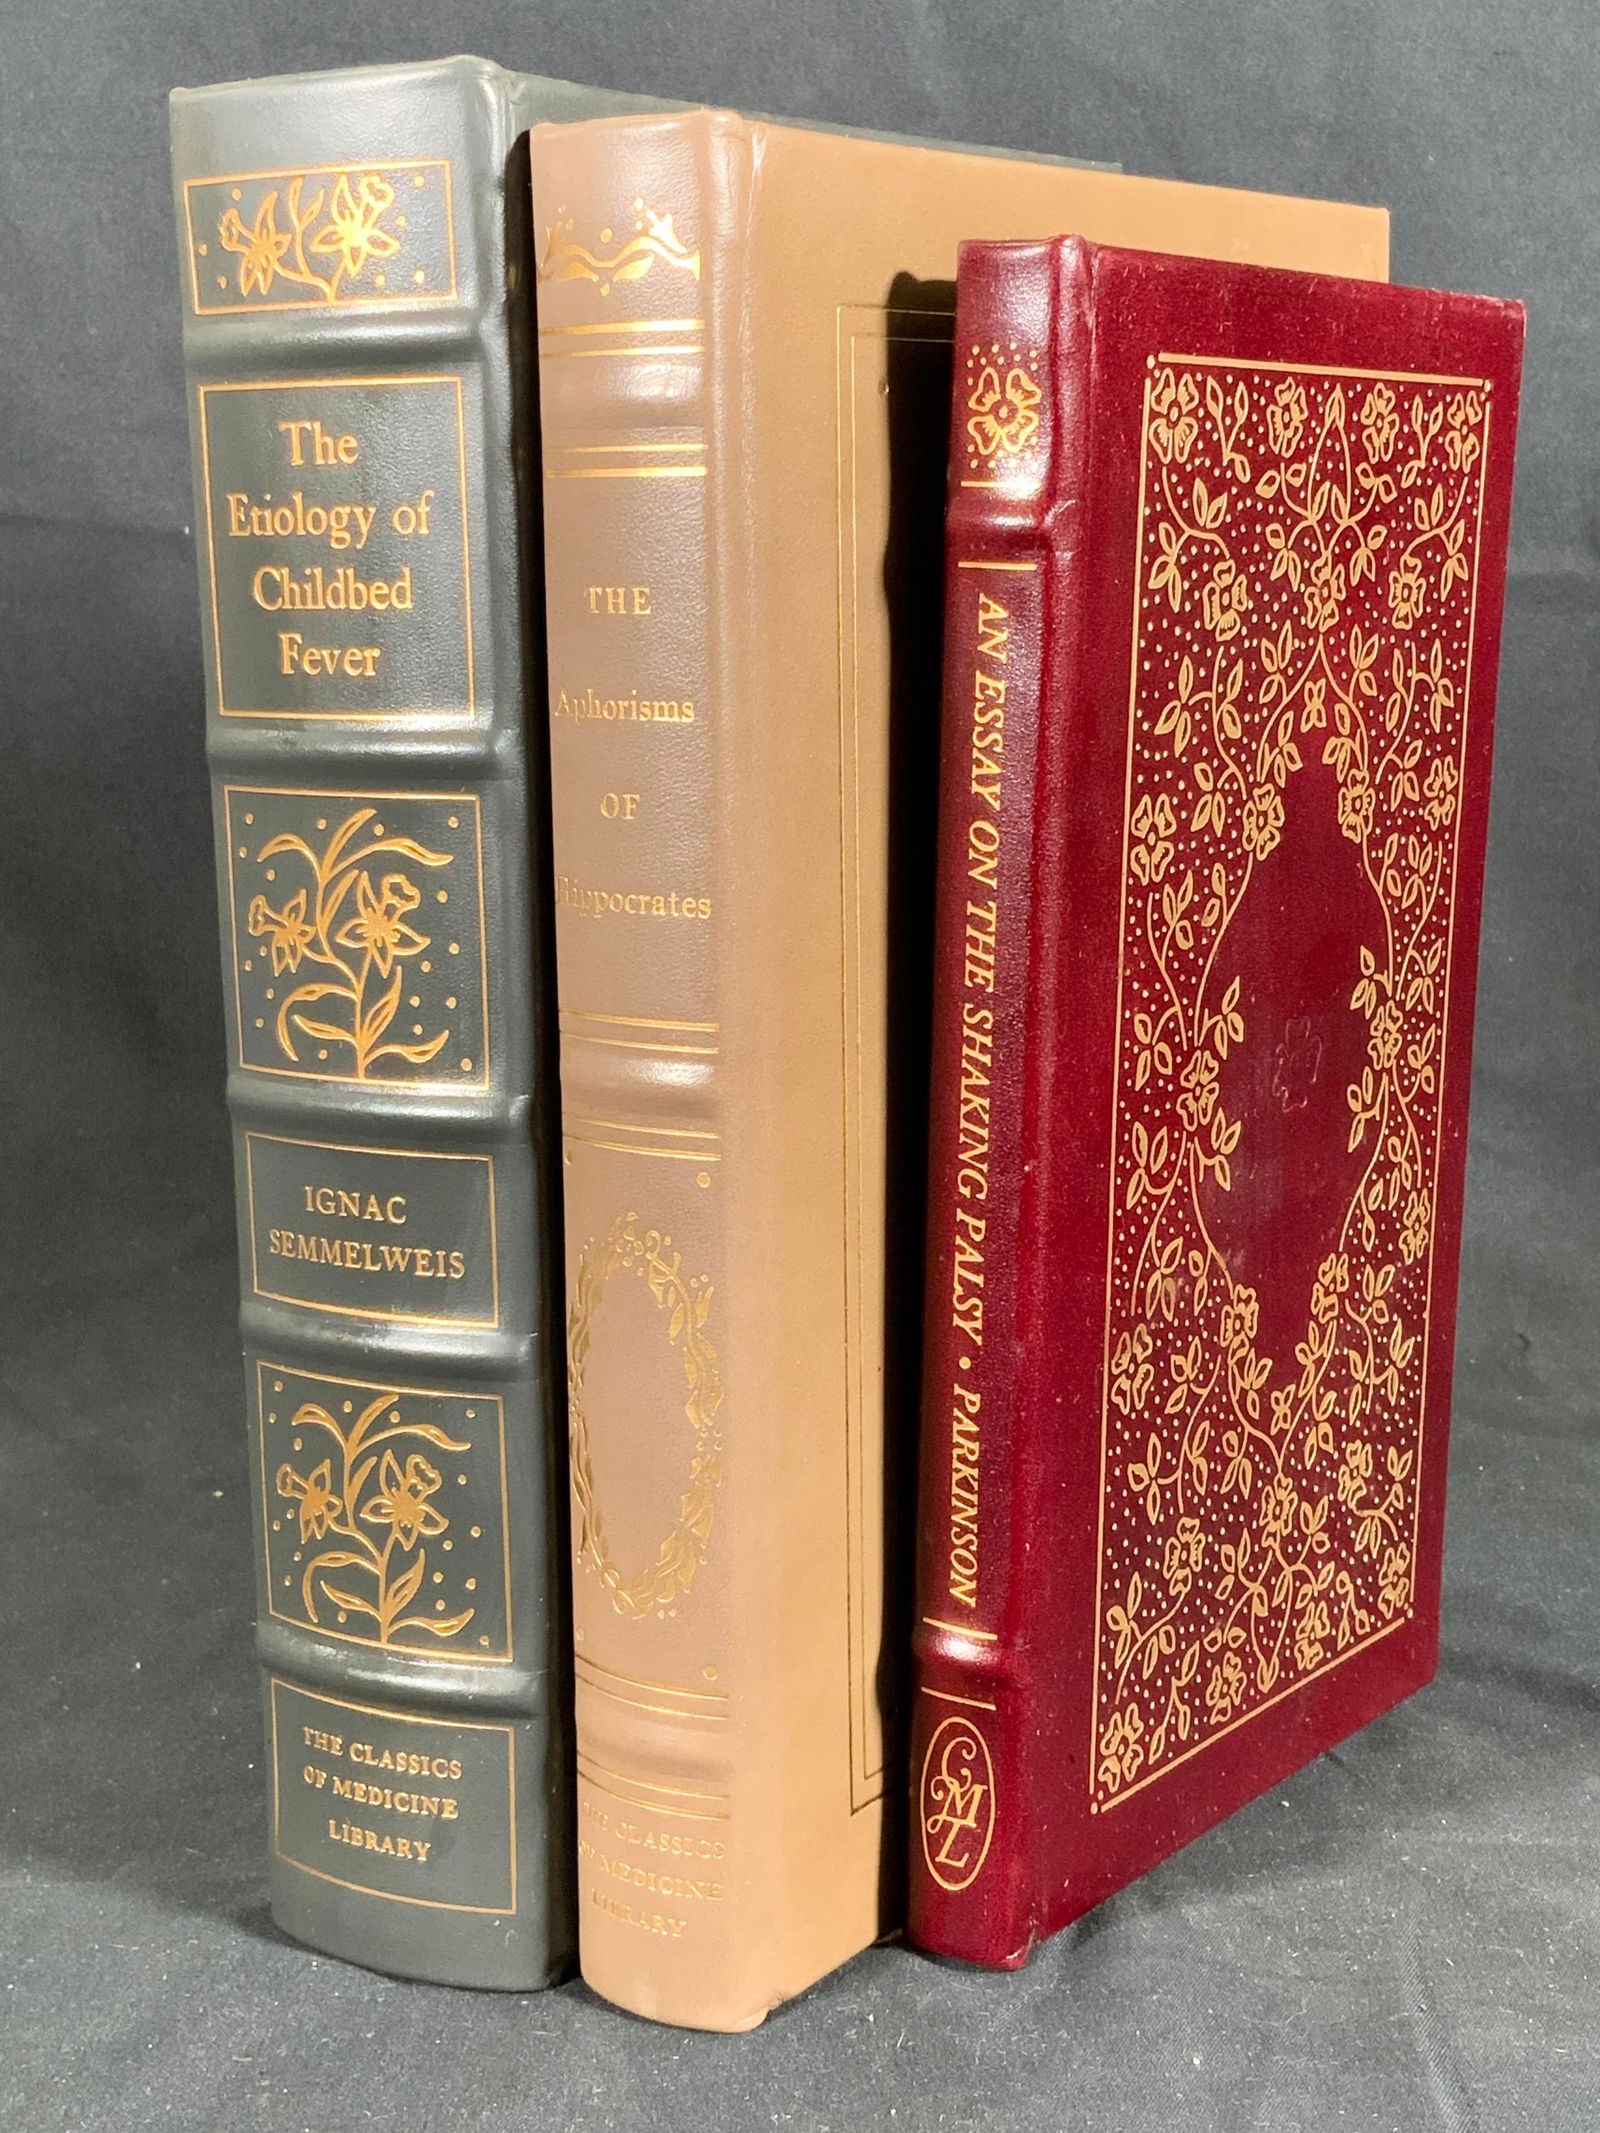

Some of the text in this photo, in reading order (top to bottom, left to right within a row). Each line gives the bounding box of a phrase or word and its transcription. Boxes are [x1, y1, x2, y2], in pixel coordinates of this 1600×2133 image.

[278, 419, 359, 466] The
[227, 489, 435, 549] Etiology of
[253, 565, 414, 611] Childbed
[584, 587, 652, 615] THE
[278, 631, 381, 676] Fever
[554, 689, 695, 723] Aphorisms
[600, 793, 641, 819] OF
[949, 593, 1009, 1608] AN ESSAY ON THE SHAKING PALSY PARKINSON
[304, 1185, 407, 1224] IGNAC
[269, 1228, 466, 1280] SEMMELWEIS
[303, 1726, 463, 1780] THE CLASSICS
[303, 1765, 459, 1819] OF MEDICINE
[328, 1819, 431, 1862] LIBRARY
[615, 1821, 726, 1860] CLASSICS
